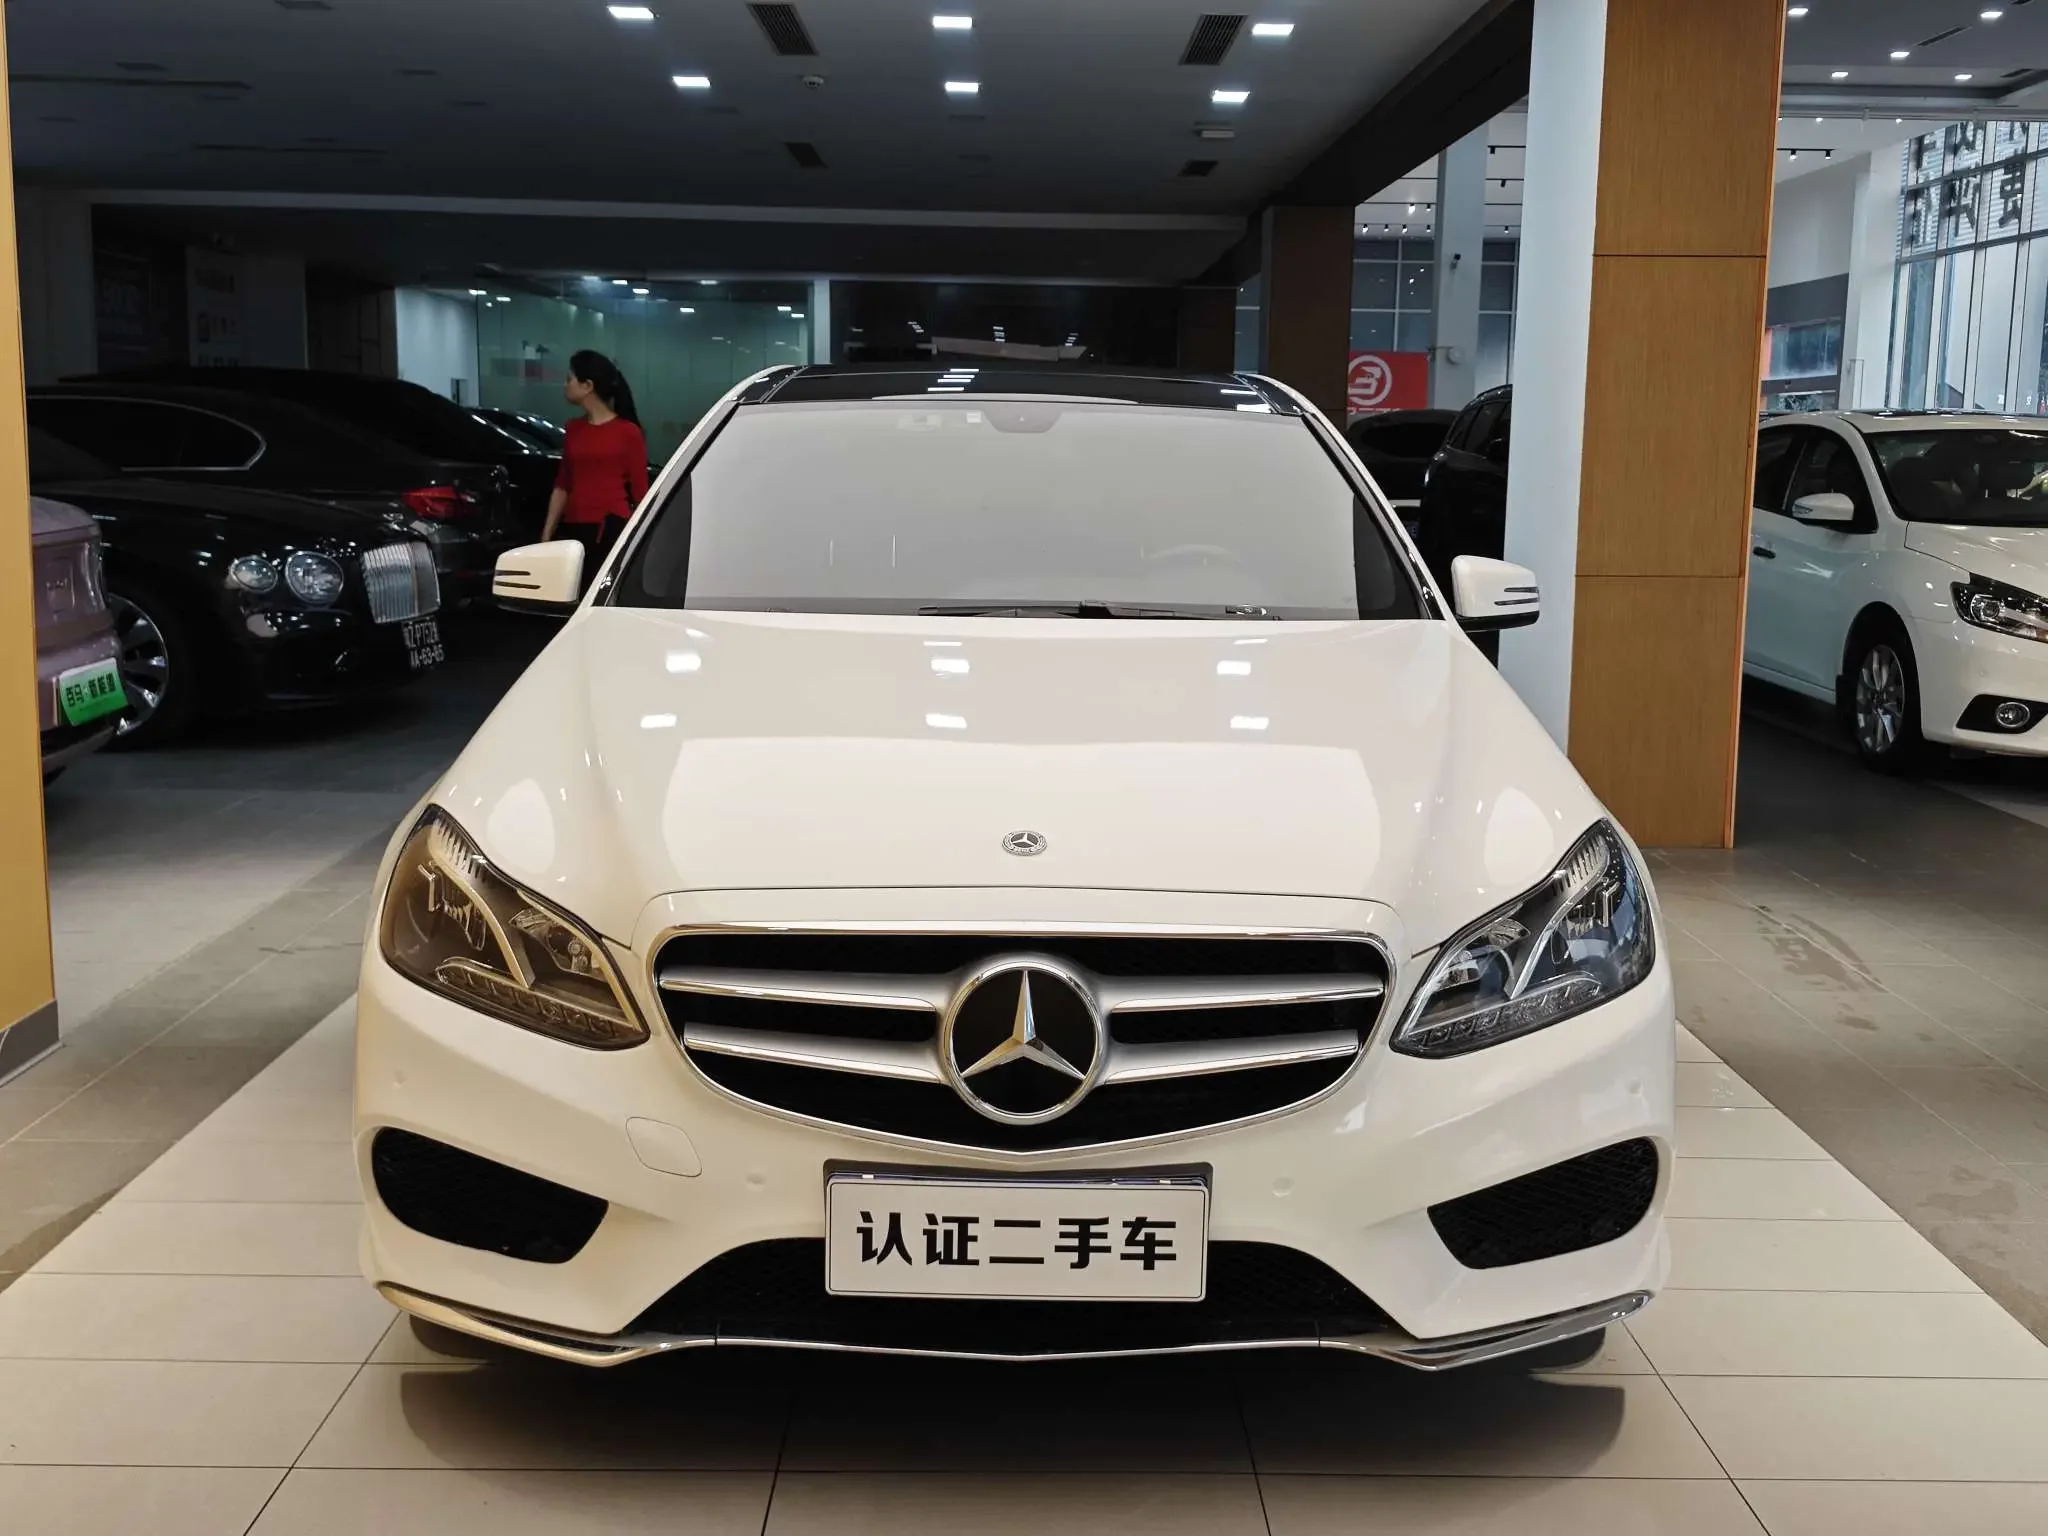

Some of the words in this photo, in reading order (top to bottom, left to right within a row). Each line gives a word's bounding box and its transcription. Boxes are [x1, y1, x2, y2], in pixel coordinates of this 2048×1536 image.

[856, 1211, 1177, 1271] 认证二手车
